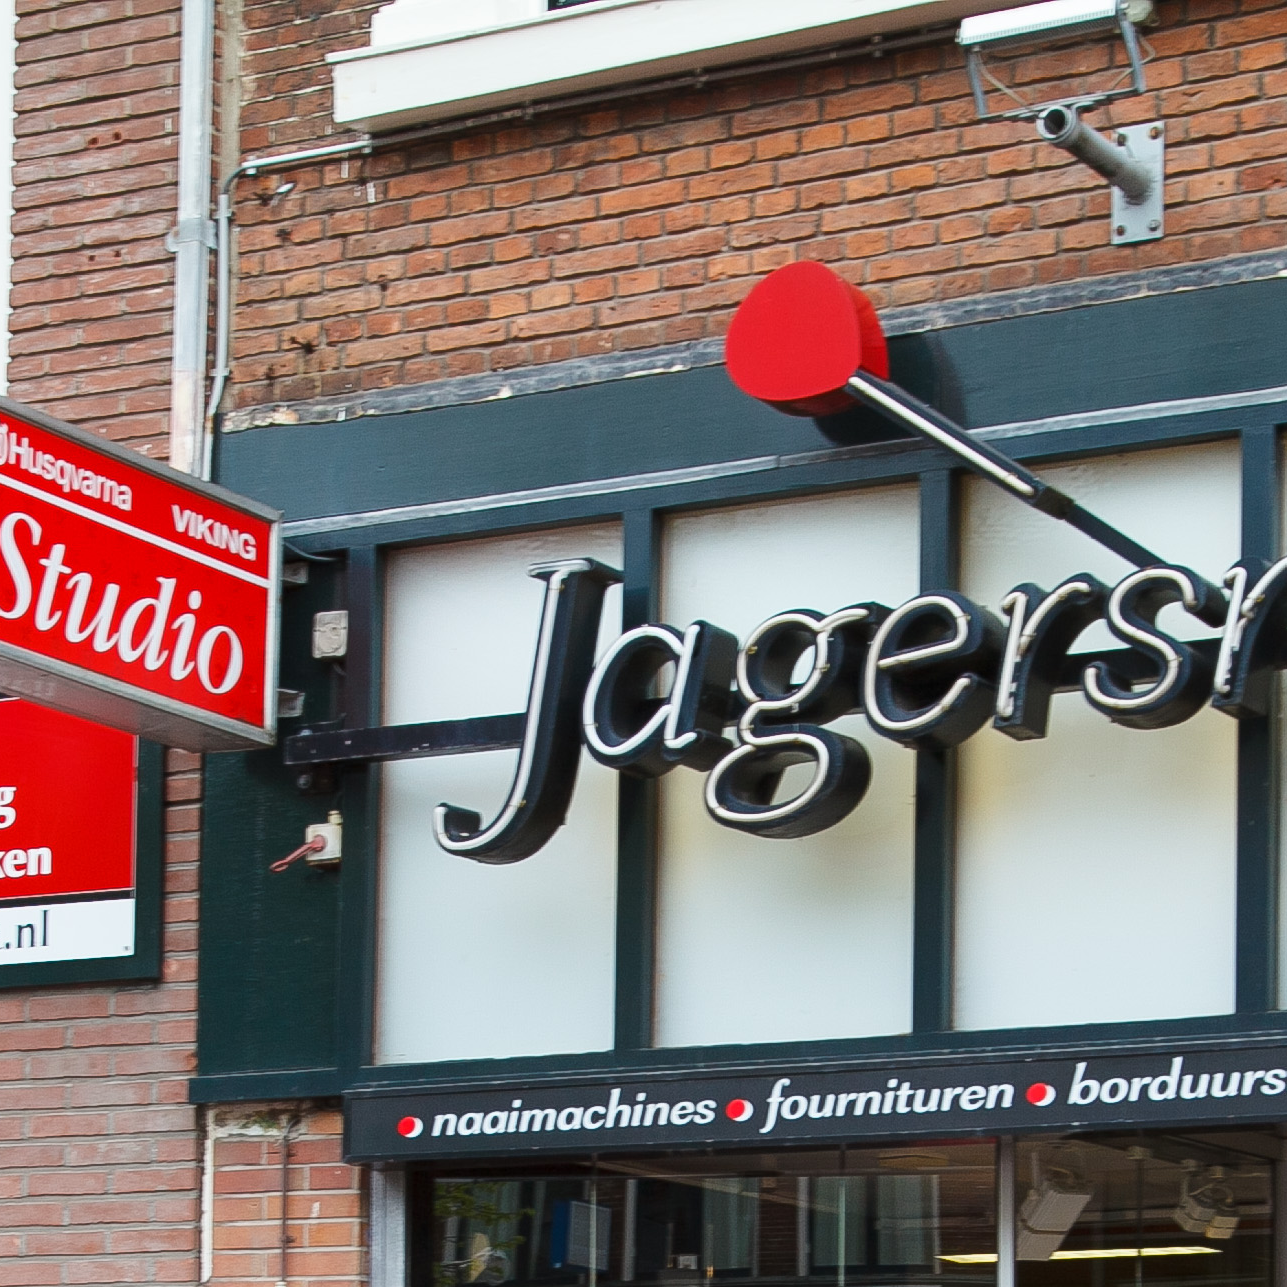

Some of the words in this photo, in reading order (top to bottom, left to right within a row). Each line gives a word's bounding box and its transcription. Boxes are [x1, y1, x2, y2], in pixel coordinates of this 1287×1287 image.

[8, 432, 133, 510] Husqvarna
[171, 504, 257, 561] VIKING
[432, 1089, 717, 1137] naaimachines
[759, 1078, 1014, 1133] fournituren
